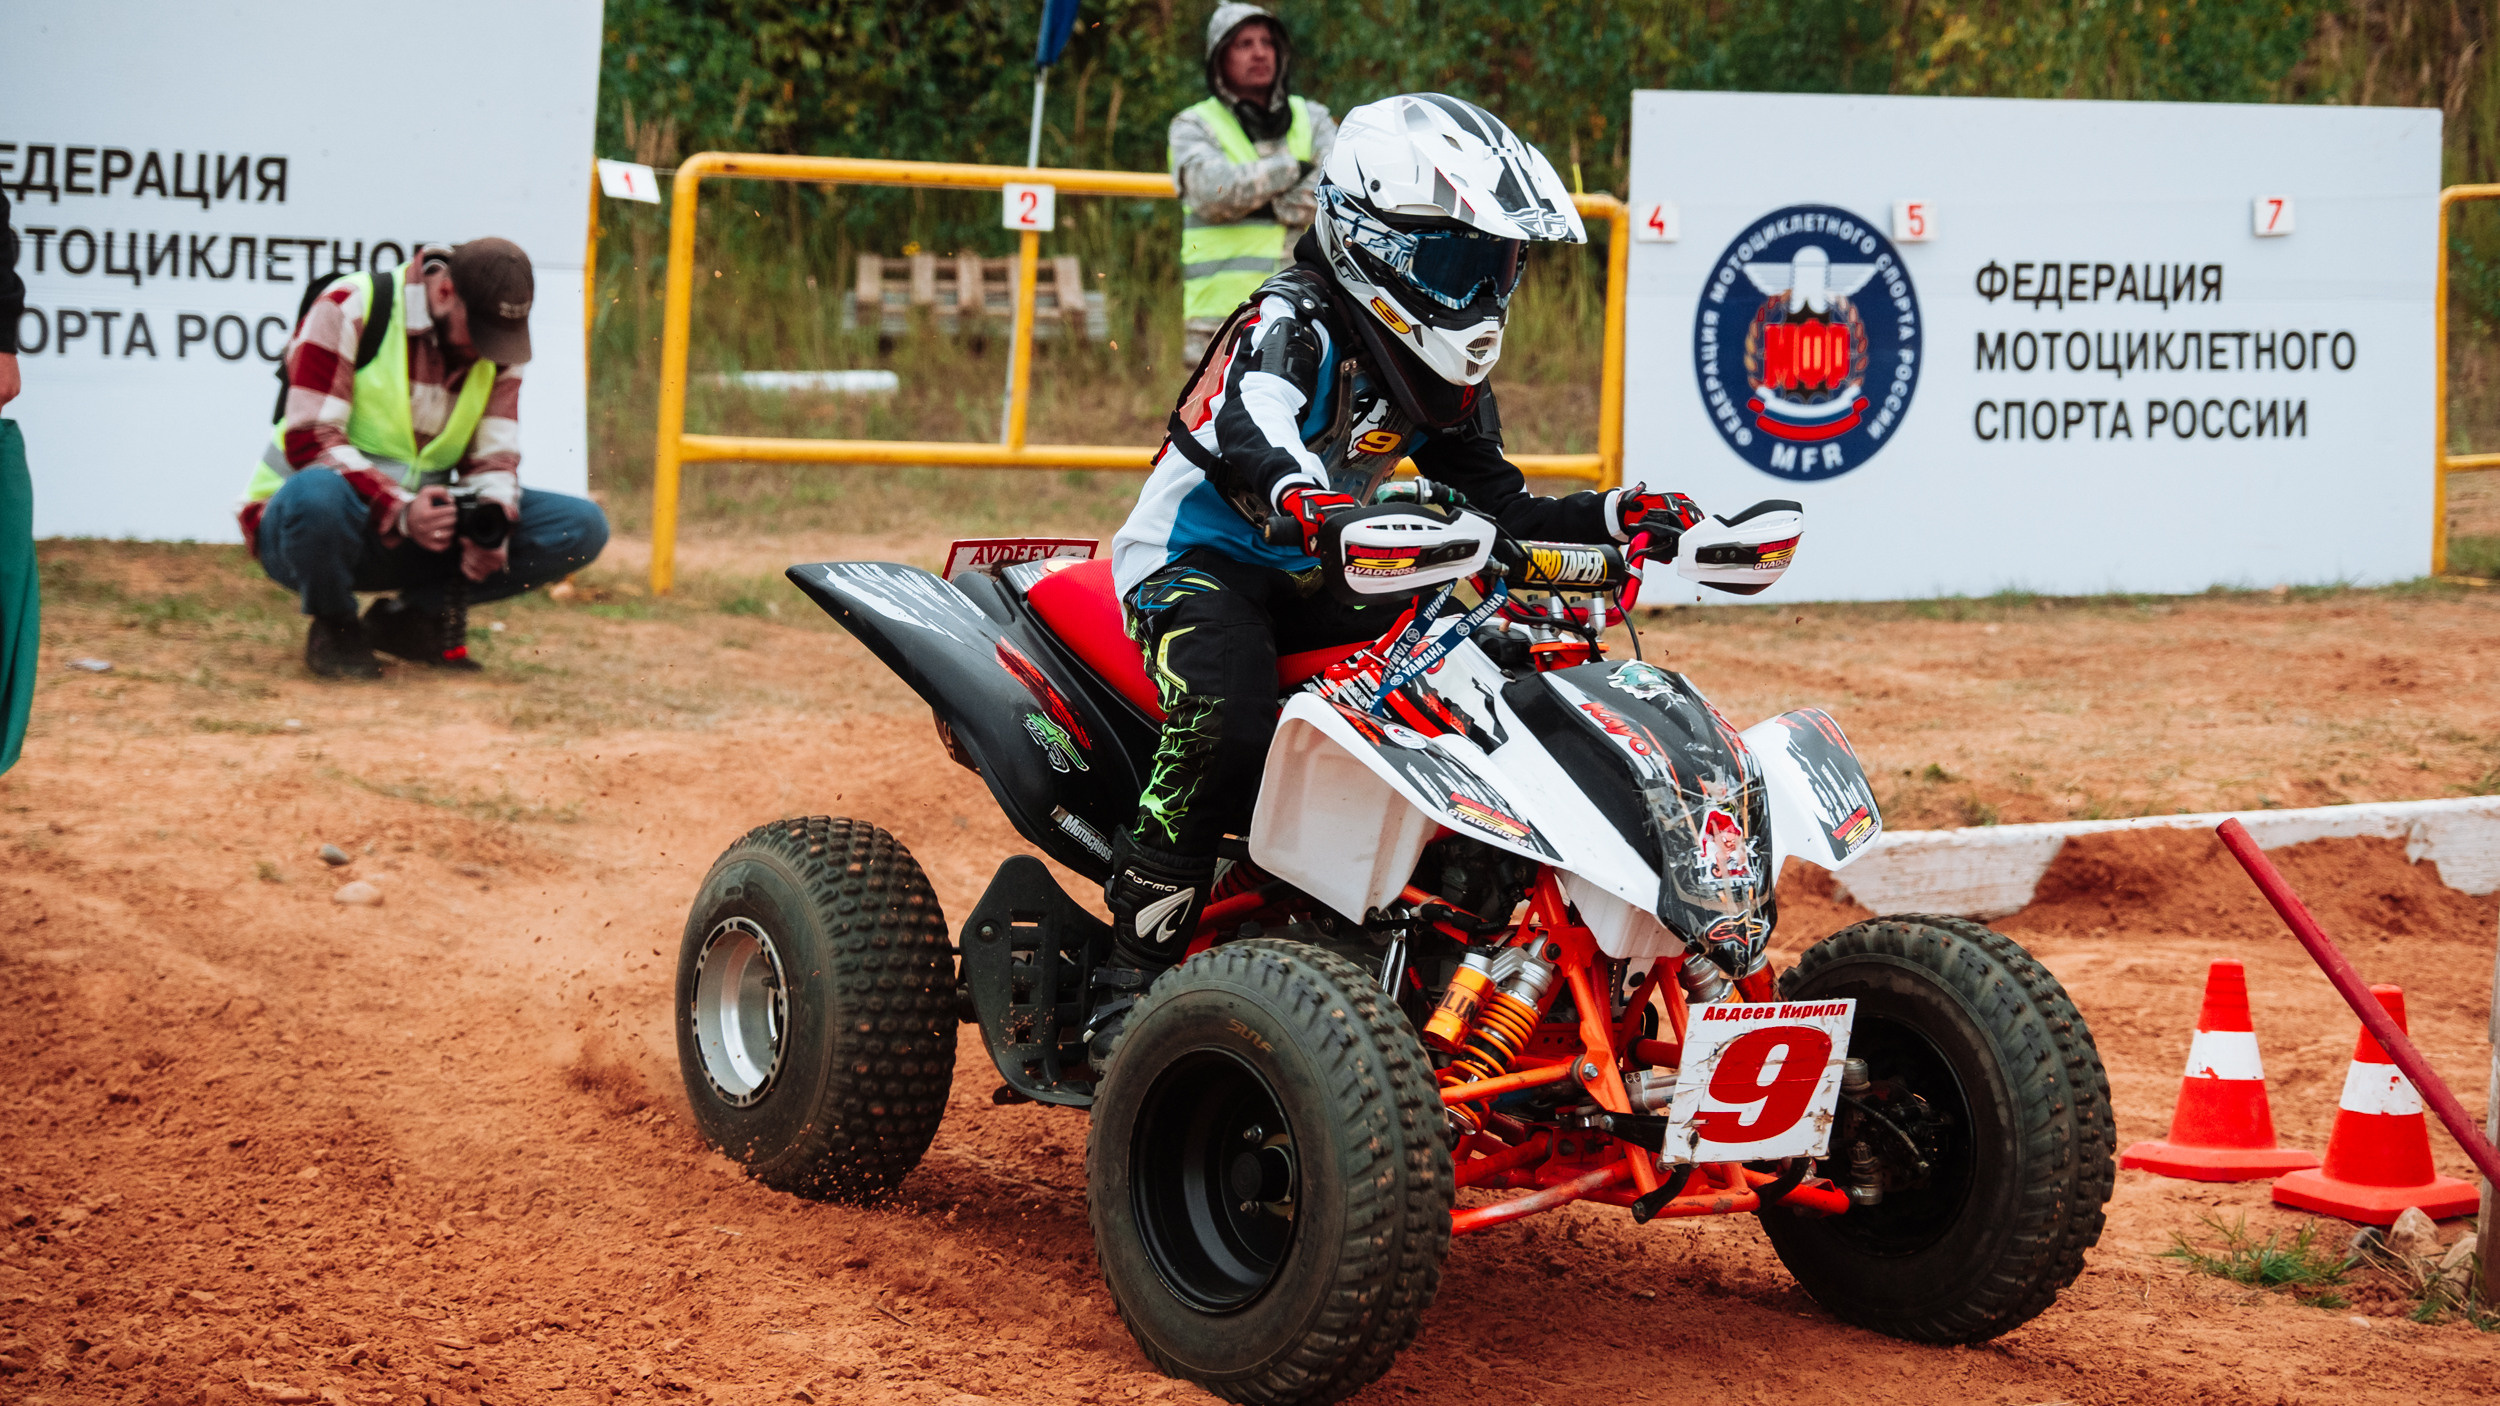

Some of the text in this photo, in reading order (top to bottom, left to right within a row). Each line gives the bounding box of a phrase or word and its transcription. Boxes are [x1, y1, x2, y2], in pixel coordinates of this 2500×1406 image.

[624, 171, 635, 194] 1
[1020, 191, 1037, 224] 2
[1647, 205, 1665, 236] 4
[1907, 204, 1925, 237] 5
[2266, 198, 2283, 231] 7
[1708, 212, 1878, 306] МОТОЦИКЛЕТНОГО
[1875, 252, 1917, 342] СПОРТА
[1975, 260, 2223, 311] ФЕДЕРАЦИЯ
[1975, 330, 2357, 380] МОТОЦИКЛЕТНОГО
[1866, 348, 1915, 440] РОССИИ
[1974, 399, 2309, 441] СПОРТА РОССИИ
[1356, 429, 1402, 455] 9
[1770, 442, 1845, 473] MFR
[1466, 592, 1506, 627] YAMAHA
[1402, 641, 1447, 677] YAMAHA
[1061, 814, 1113, 861] MOTOCROSS
[1703, 1003, 1848, 1023] Авдеев Кирилл
[1693, 1025, 1833, 1143] 9
